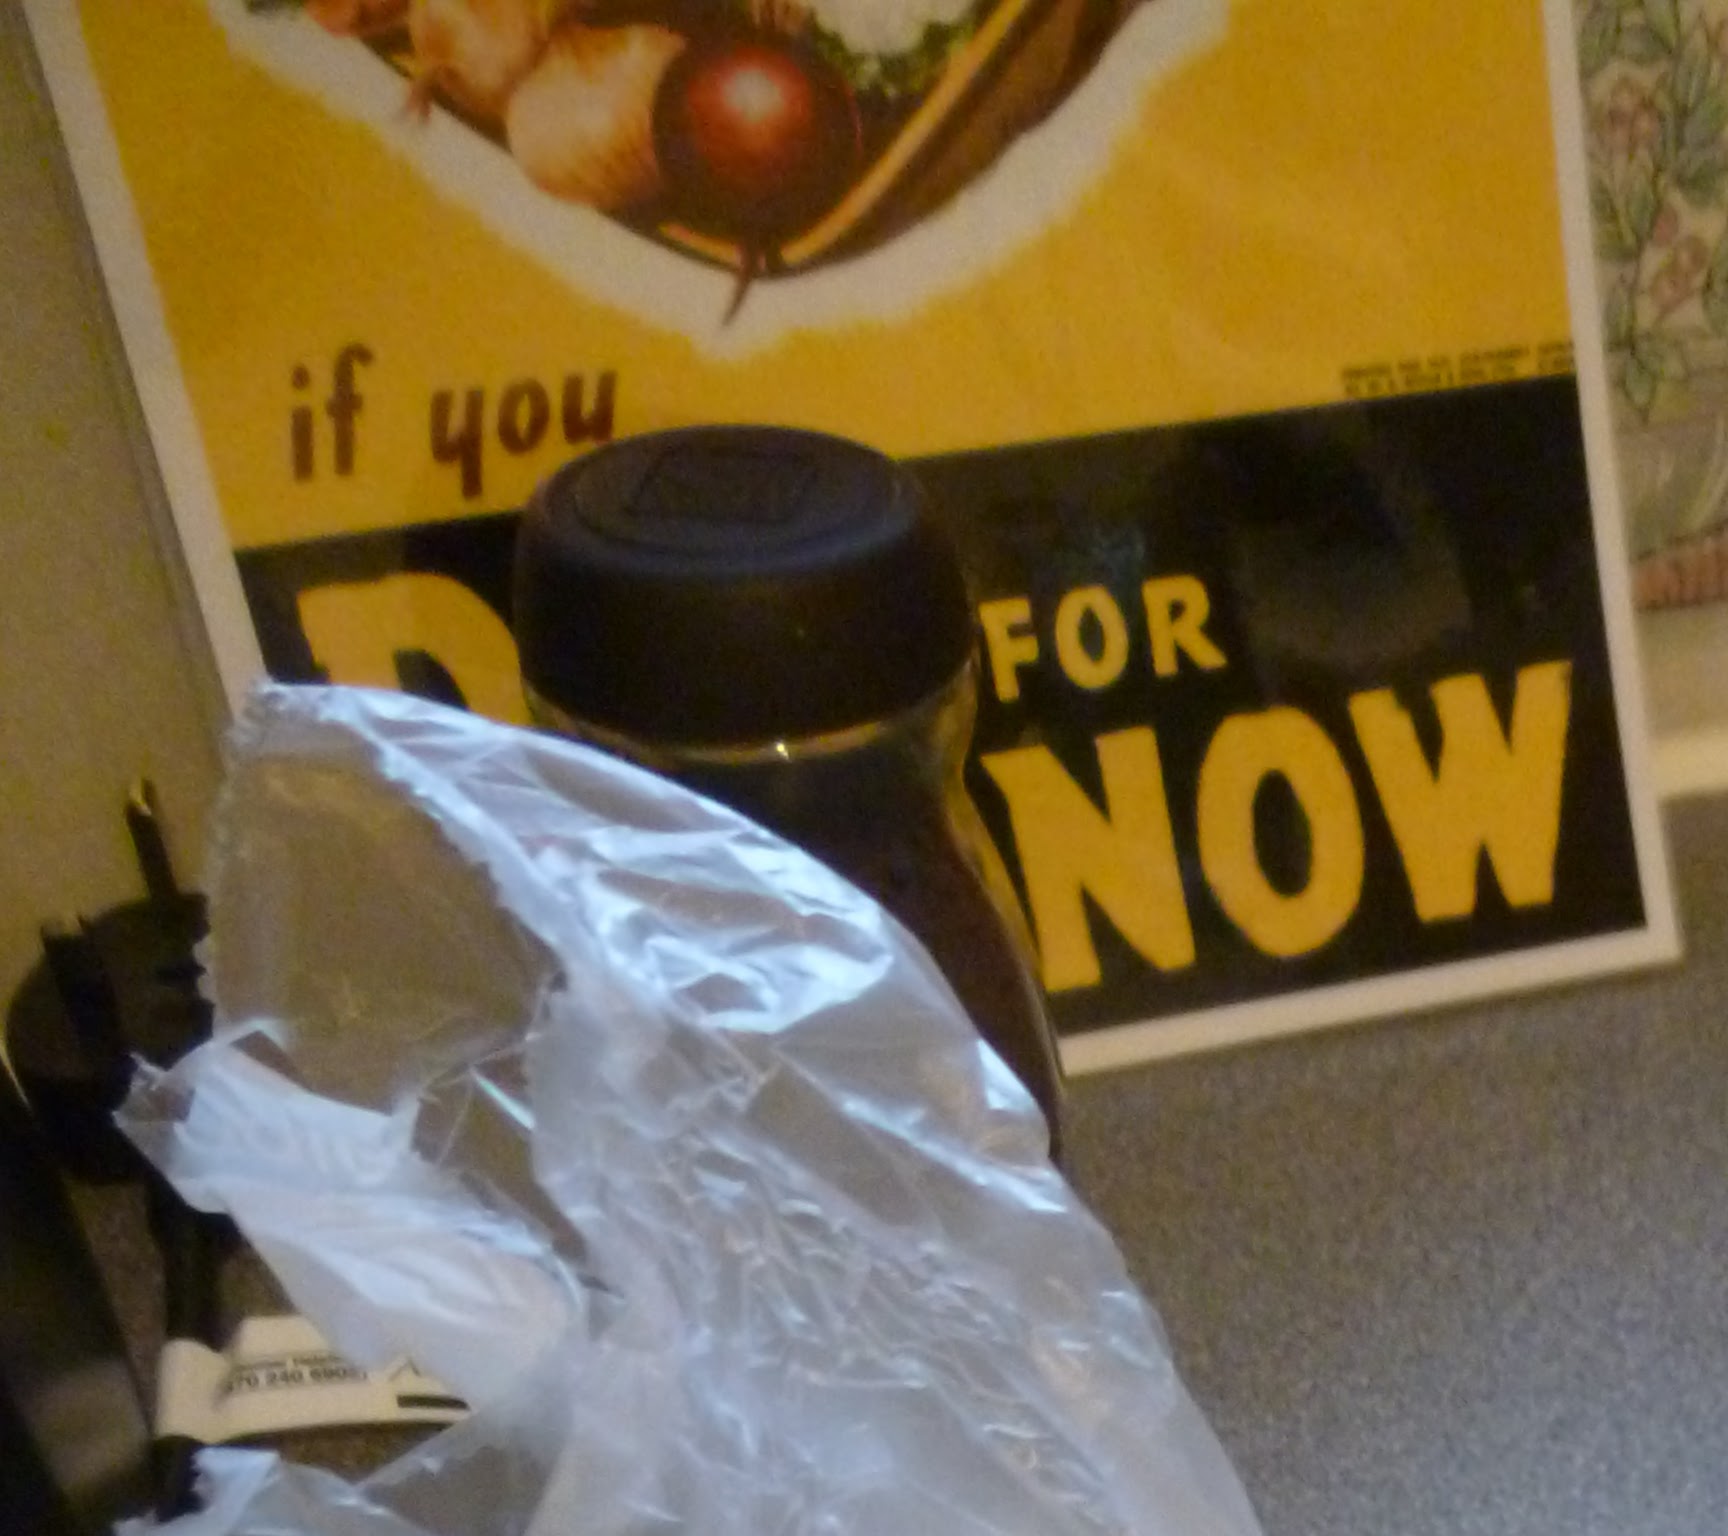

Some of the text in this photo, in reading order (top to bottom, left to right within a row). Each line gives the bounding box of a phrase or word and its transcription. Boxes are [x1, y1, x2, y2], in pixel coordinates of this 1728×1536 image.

[290, 343, 617, 498] if you
[978, 574, 1227, 700] FOR
[981, 659, 1573, 992] NOW
